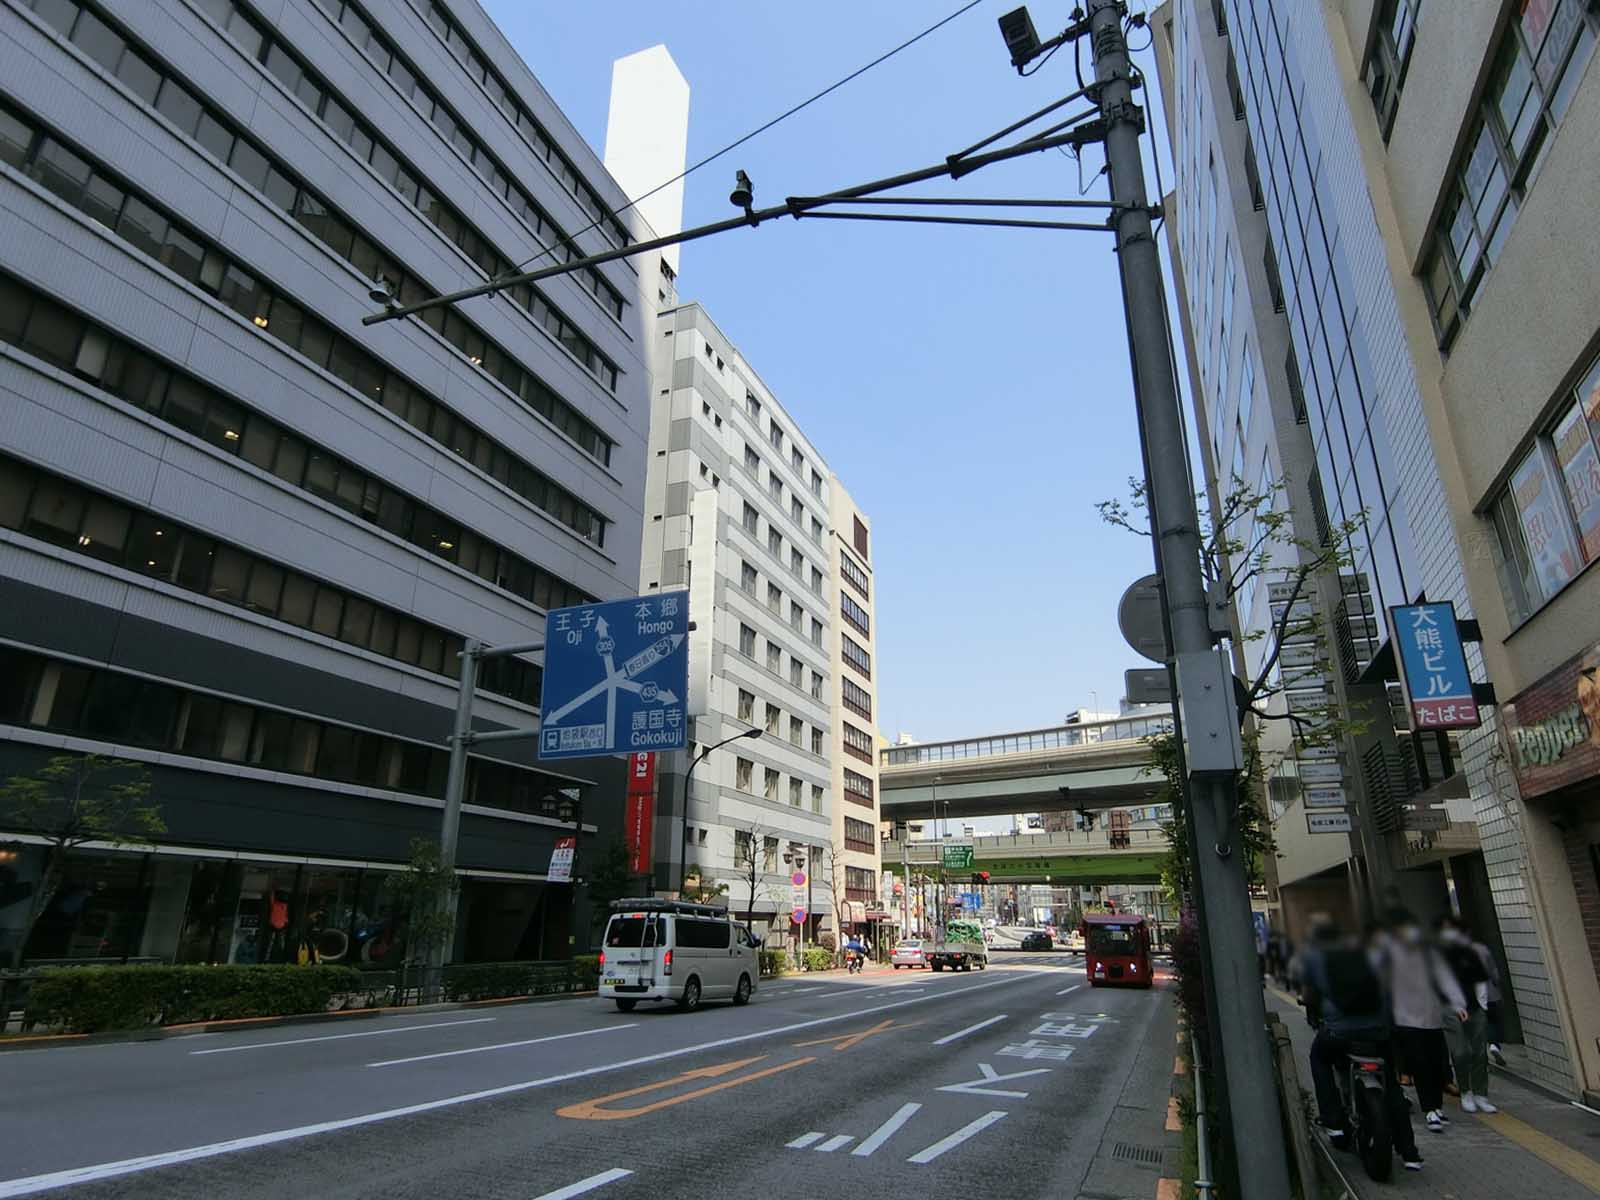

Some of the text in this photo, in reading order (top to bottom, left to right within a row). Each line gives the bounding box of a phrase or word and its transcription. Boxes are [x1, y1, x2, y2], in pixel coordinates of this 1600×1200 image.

[634, 598, 678, 620] 本郷
[555, 609, 595, 631] 王子
[637, 620, 674, 636] Hongo
[567, 630, 583, 646] Oji
[1410, 606, 1453, 696] 大熊ビル
[632, 708, 682, 731] 護国寺
[1416, 705, 1475, 725] たばこ
[631, 728, 682, 746] Gokokuji
